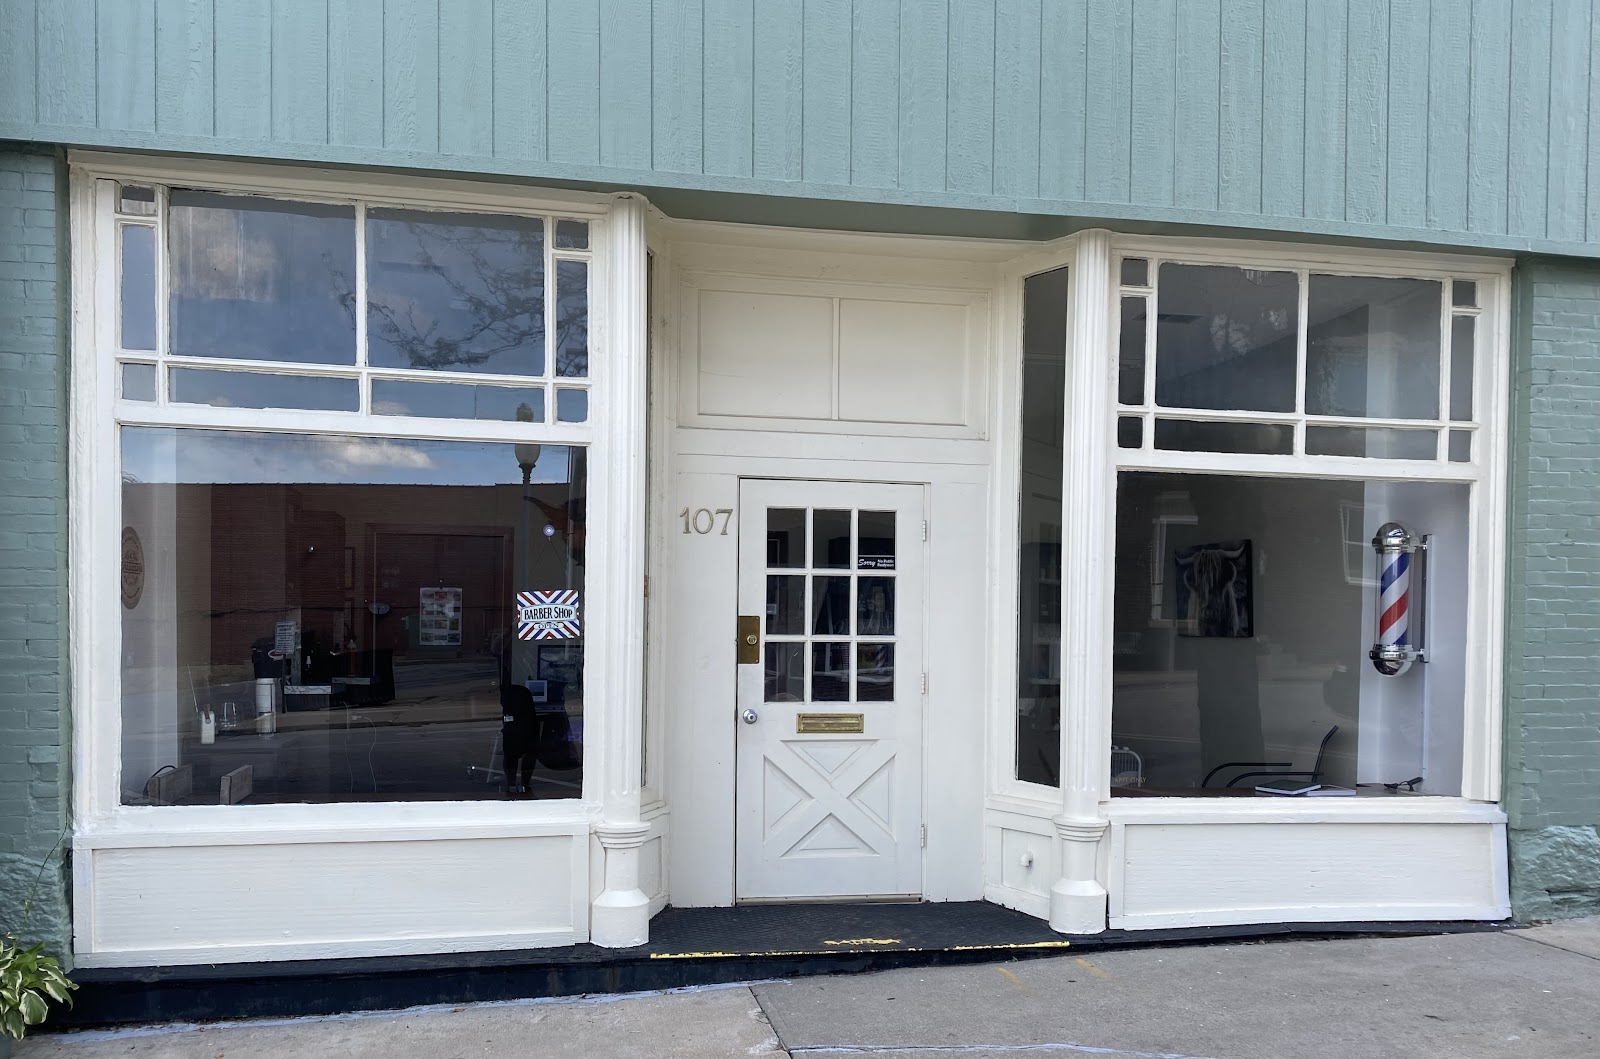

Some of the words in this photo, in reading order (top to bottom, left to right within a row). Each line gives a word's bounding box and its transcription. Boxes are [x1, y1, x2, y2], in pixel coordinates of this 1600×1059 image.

[679, 506, 734, 535] 107
[858, 558, 876, 567] Sorry
[524, 607, 552, 620] BARBER
[553, 606, 572, 618] SHOP
